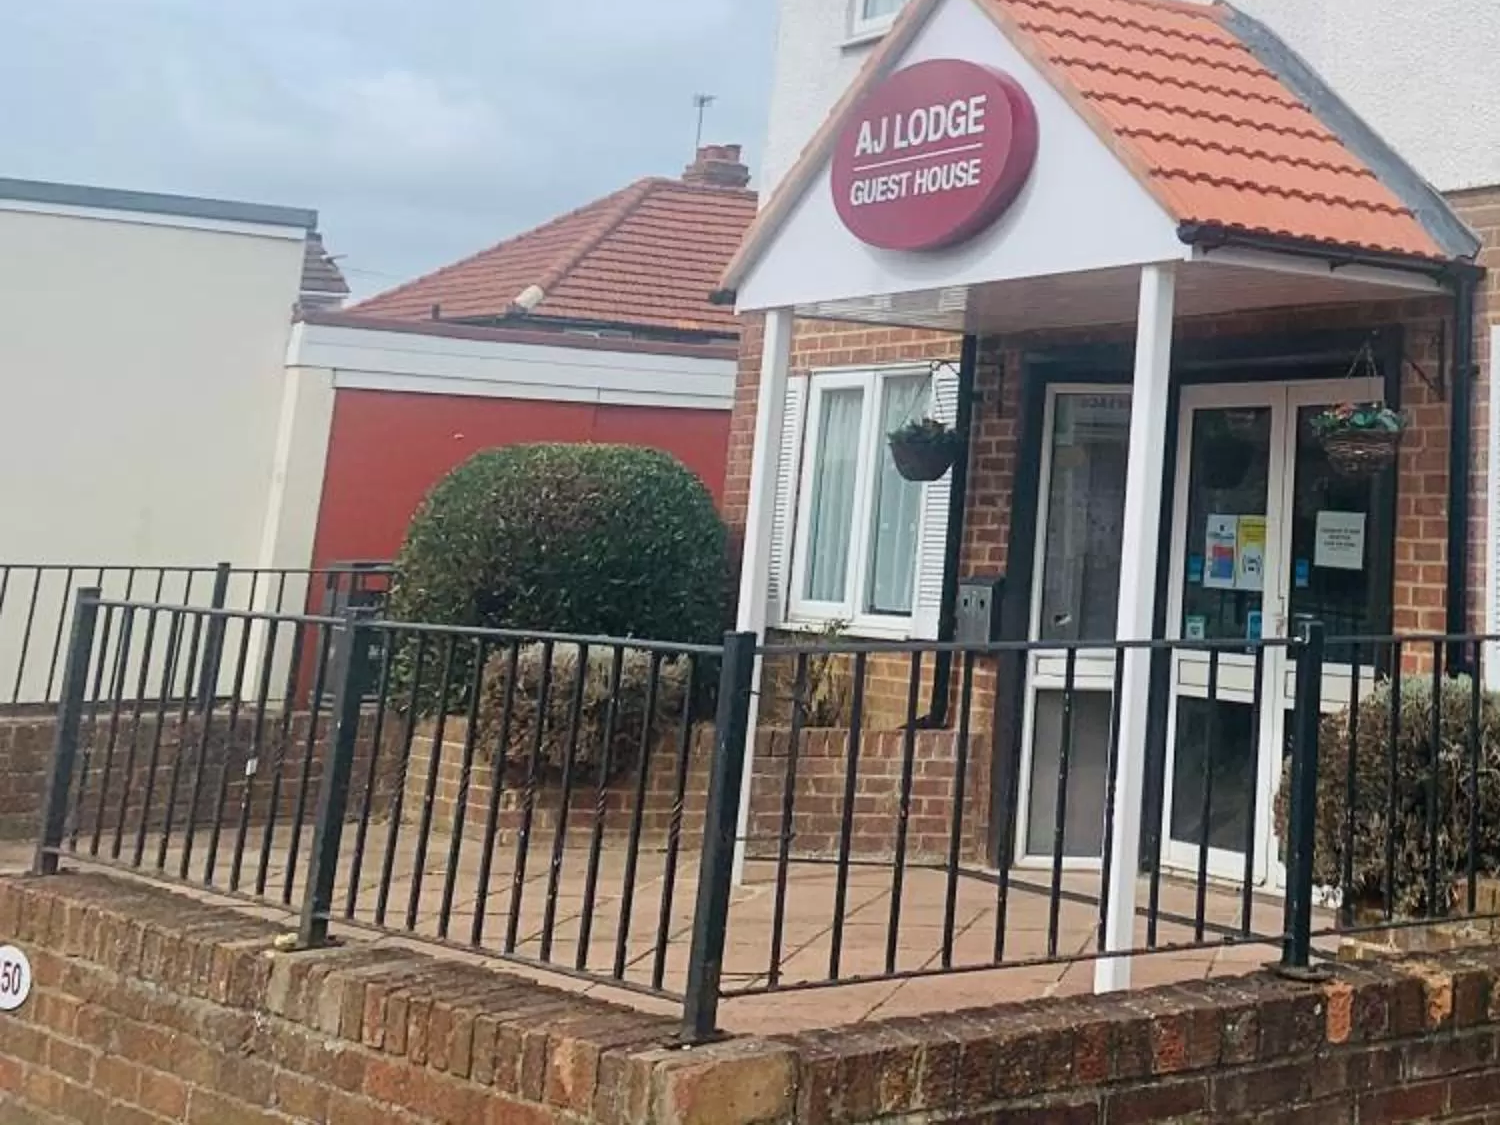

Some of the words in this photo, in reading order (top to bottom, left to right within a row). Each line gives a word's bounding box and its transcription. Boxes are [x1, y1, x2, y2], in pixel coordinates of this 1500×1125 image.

[854, 117, 888, 157] AJ
[893, 94, 988, 150] LODGE
[850, 171, 912, 207] GUEST
[913, 158, 982, 196] HOUSE
[1, 960, 22, 996] 50
